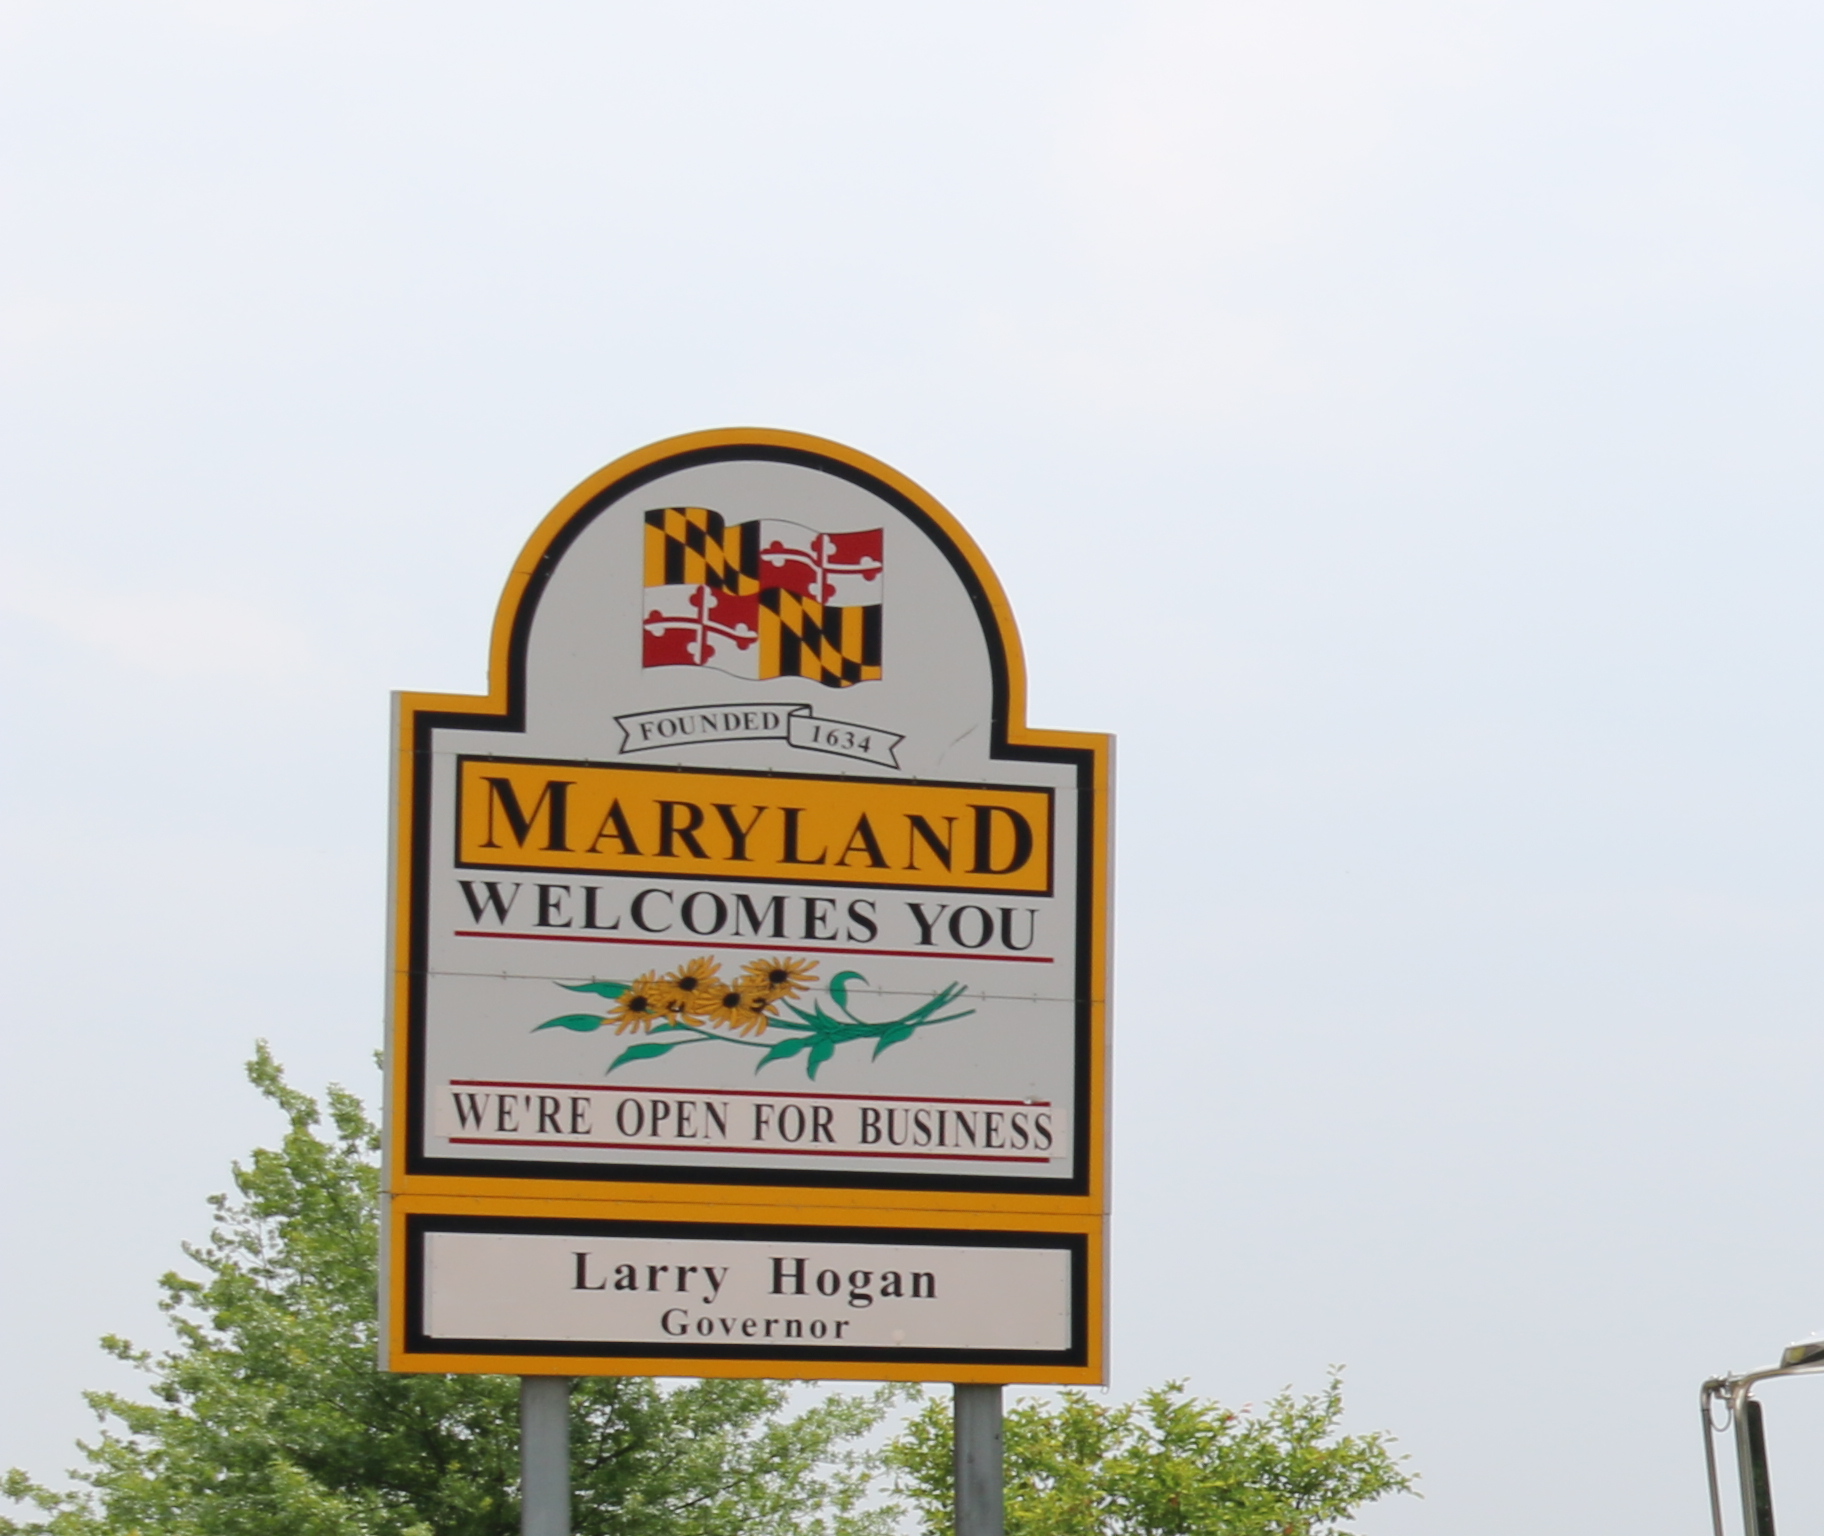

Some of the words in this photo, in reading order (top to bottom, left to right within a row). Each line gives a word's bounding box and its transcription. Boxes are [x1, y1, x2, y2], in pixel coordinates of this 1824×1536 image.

[639, 709, 781, 742] FOUNDED
[810, 724, 873, 754] 1634
[457, 880, 879, 944] WELCOMES
[903, 902, 1040, 951] YOU
[452, 1092, 594, 1136] WE'RE
[616, 1098, 730, 1141] OPEN
[753, 1104, 836, 1143] FOR
[859, 1107, 1054, 1151] BUSINESS
[572, 1251, 730, 1304] Larry
[769, 1257, 938, 1307] Hogan
[660, 1308, 850, 1340] Governor
